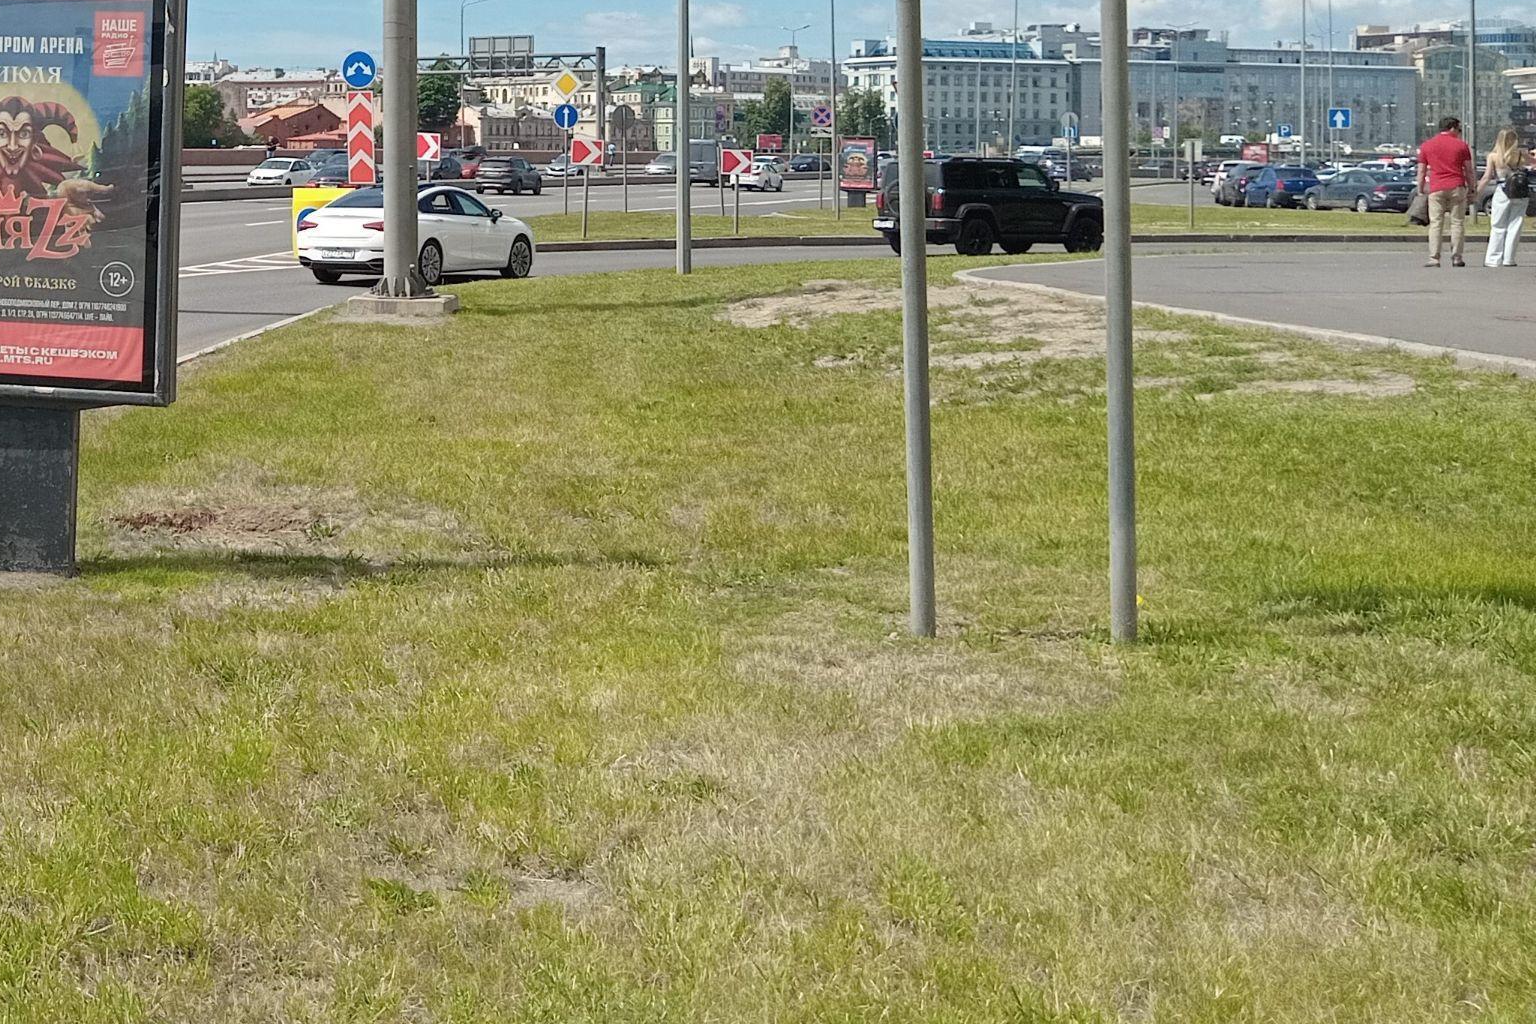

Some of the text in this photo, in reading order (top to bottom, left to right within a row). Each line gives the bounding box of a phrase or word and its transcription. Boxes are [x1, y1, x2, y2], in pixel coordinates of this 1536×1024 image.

[101, 19, 137, 32] НАШЕ
[101, 32, 129, 40] РАДИО
[39, 36, 84, 54] АРЕНА
[24, 277, 78, 290] СКАЗКЕ
[107, 272, 128, 288] 12+
[30, 346, 39, 356] С
[41, 347, 118, 360] КЕШБЭКОМ
